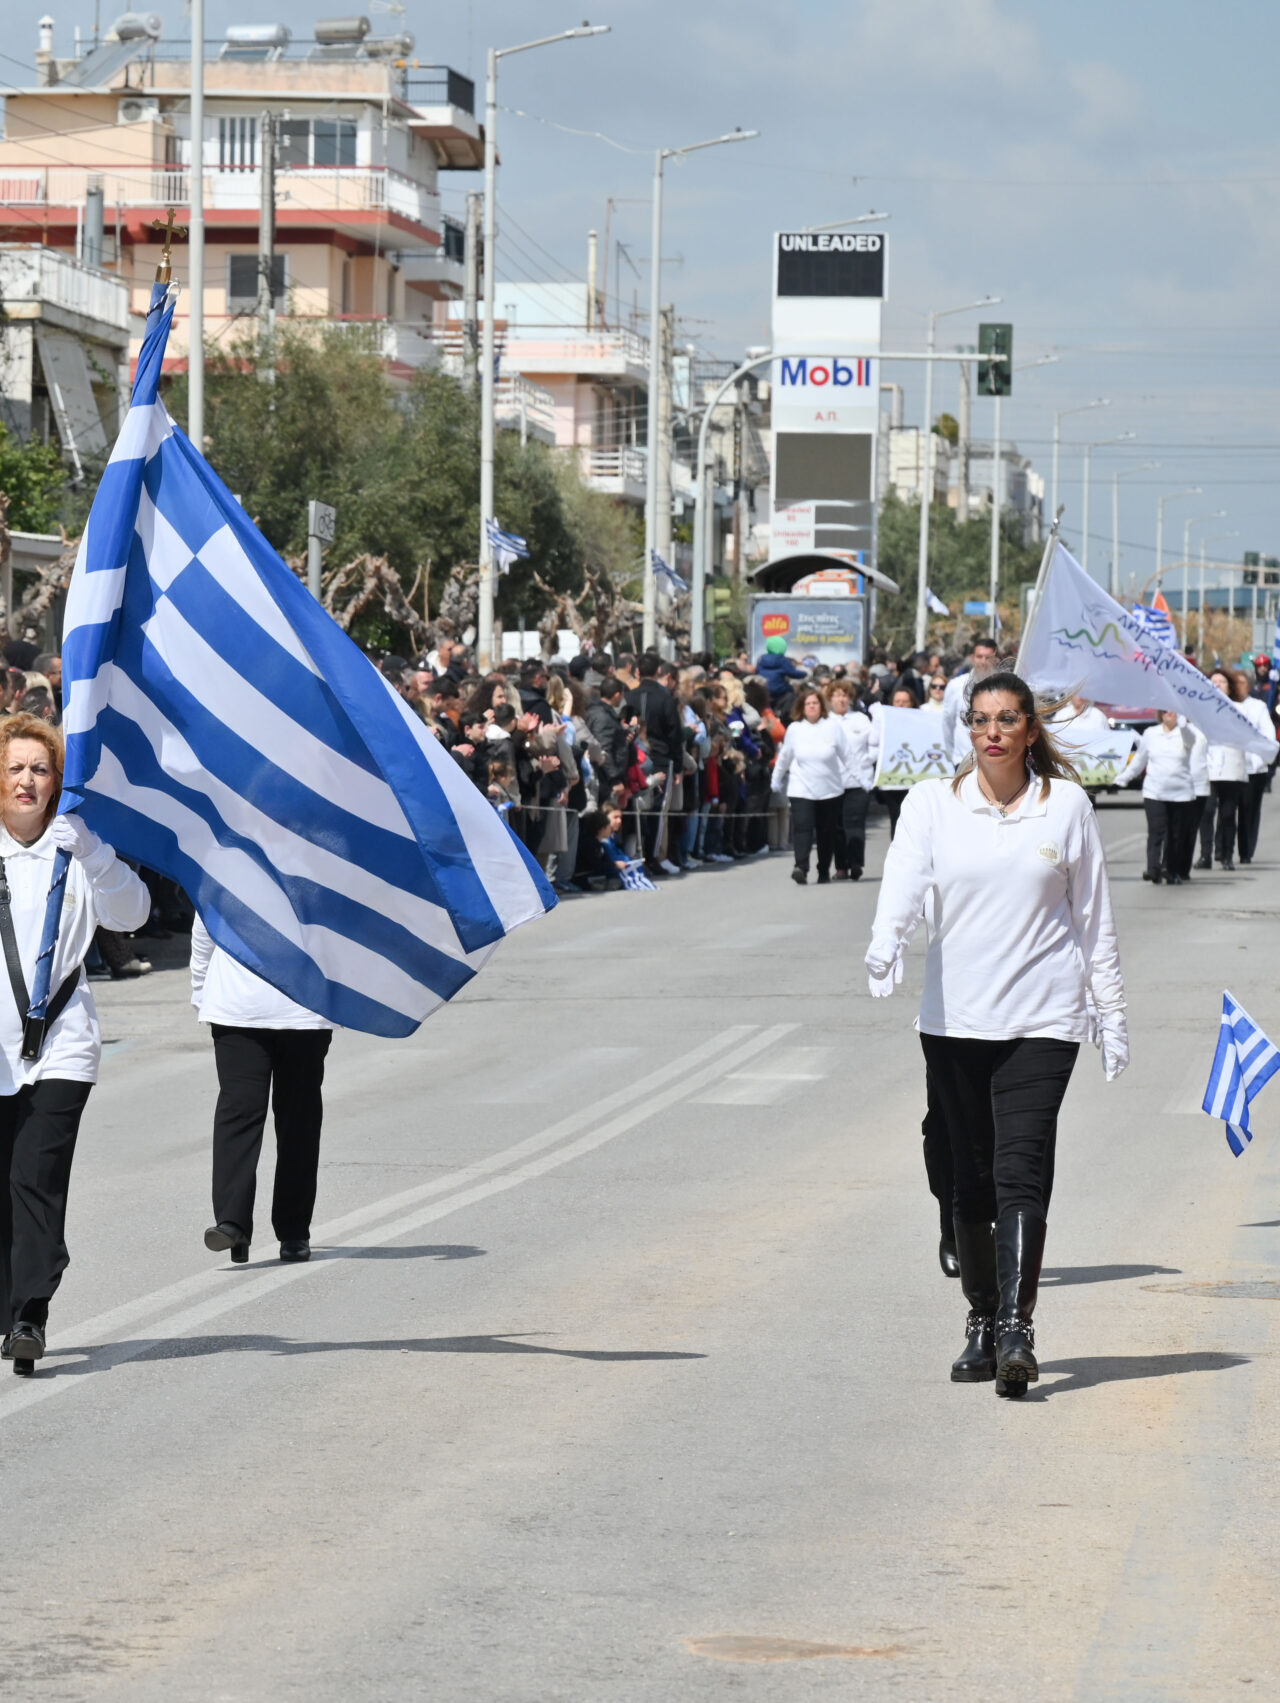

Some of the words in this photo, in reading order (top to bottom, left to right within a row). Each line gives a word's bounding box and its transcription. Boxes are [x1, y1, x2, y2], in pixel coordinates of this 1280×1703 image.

[781, 235, 881, 252] UNLEADED
[781, 357, 870, 387] Mobil
[763, 617, 787, 630] alfa
